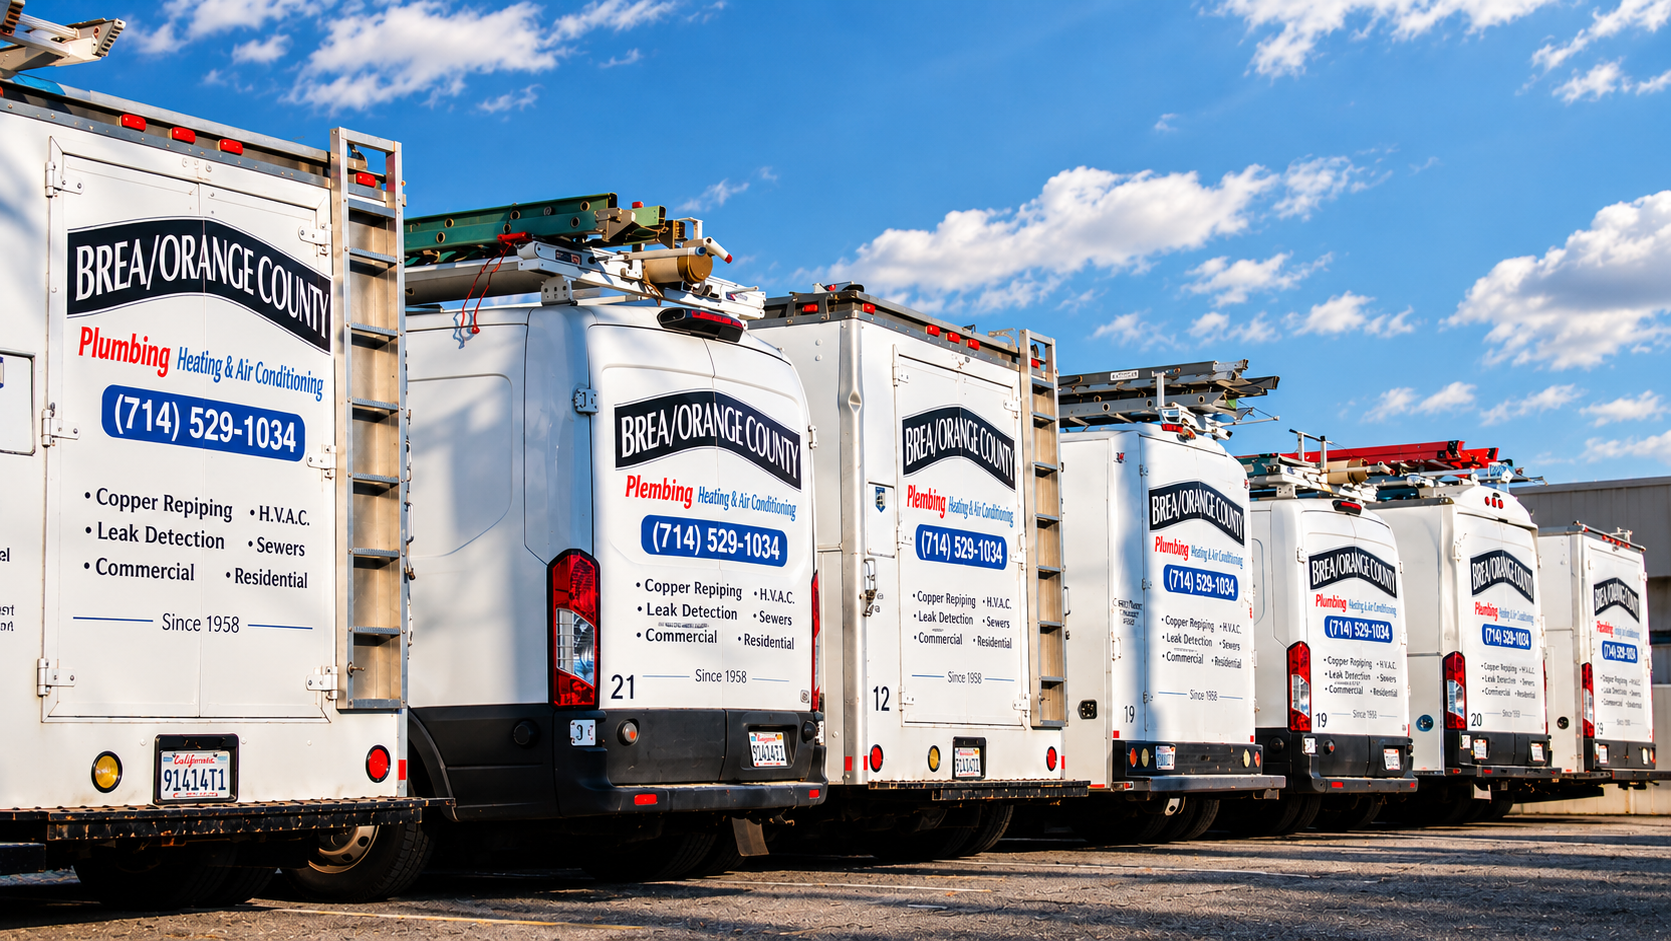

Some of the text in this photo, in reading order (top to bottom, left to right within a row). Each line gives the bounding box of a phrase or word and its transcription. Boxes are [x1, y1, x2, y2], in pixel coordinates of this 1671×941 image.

[75, 234, 329, 339] BREA/ORANGE COUNTY
[78, 326, 324, 401] Plumbing Heating & Air Conditioning
[114, 393, 296, 453] (714) 529-1034
[621, 402, 798, 479] BREA/ORANGE COUNTY
[906, 417, 1014, 481] BREA/ORANGE COUNTY
[96, 487, 233, 522] Copper Repiping
[698, 486, 729, 510] Heating
[732, 490, 737, 507] &
[739, 492, 750, 508] Air
[751, 495, 796, 522] Conditioning
[259, 505, 310, 526] H.V.A.C.
[1152, 489, 1244, 540] BREA/ORANGE COUNTY
[98, 521, 225, 550] Leak Detection
[653, 521, 780, 560] (714) 529-1034
[257, 537, 305, 557] Sewers
[921, 530, 1002, 564] (714) 529-1034
[96, 558, 195, 582] Commercial
[235, 567, 308, 589] Residential
[1312, 553, 1395, 593] BREA/ORANGE COUNTY
[645, 579, 742, 600] Copper Repiping
[1169, 569, 1234, 596] (714) 529-1034
[760, 588, 795, 604] H.V.A.C.
[917, 591, 976, 608] Copper Repiping
[987, 599, 1012, 610] H.V.A.C.
[647, 603, 737, 620] Leak Detection
[760, 611, 792, 625] Sewers
[919, 611, 973, 625] Leak Detection
[162, 613, 240, 634] Since 1958
[987, 617, 1010, 628] Sewers
[1166, 615, 1188, 629] Copper
[1330, 619, 1389, 639] (714) 529-1034
[645, 629, 717, 643] Commercial
[744, 633, 794, 649] Residential
[919, 632, 962, 645] Commercial
[978, 636, 1012, 649] Residential
[1167, 633, 1212, 647] Leak Detection
[1167, 652, 1203, 664] Commercial
[695, 669, 747, 683] Since 1958
[948, 671, 982, 684] Since 1958
[611, 674, 635, 699] 21
[873, 686, 890, 711] 12
[1124, 706, 1134, 723] 19
[1316, 713, 1327, 727] 19
[1471, 713, 1482, 726] 20
[164, 769, 226, 791] 91414T1
